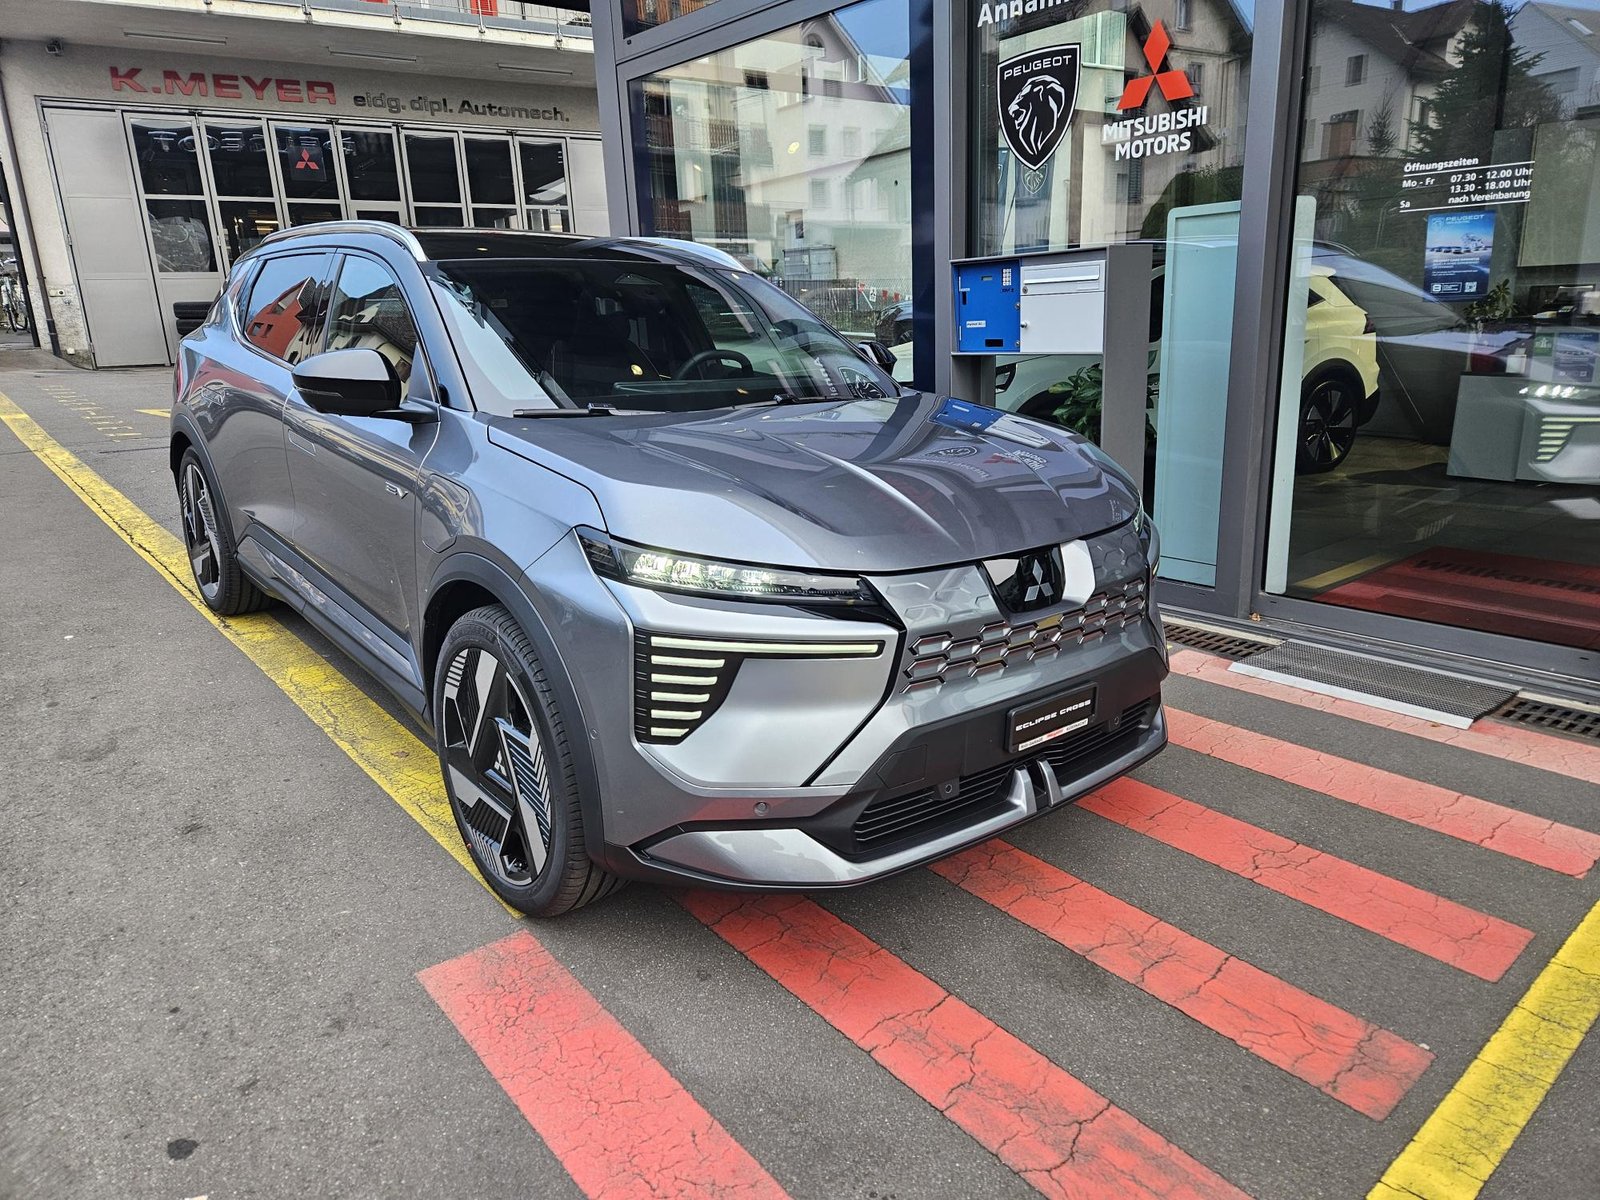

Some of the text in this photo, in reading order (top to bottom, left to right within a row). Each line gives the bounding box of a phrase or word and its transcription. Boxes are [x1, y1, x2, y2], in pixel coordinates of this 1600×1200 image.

[1003, 54, 1072, 80] PEUGEOT
[109, 66, 337, 105] K.MEYER
[353, 92, 570, 122] eidg. dipl. Automech.
[1102, 105, 1207, 141] MITSUBISHI
[1115, 131, 1191, 161] MOTORS
[1402, 180, 1417, 188] Mo
[1425, 177, 1435, 186] Fr
[1450, 173, 1477, 183] 07.30
[1486, 169, 1512, 179] 12.00
[1515, 167, 1534, 176] Uhr
[1403, 157, 1479, 173] Öffnungszeiten
[1400, 190, 1531, 209] Sa nach Vereinbarung
[1450, 184, 1476, 194] 13.30
[1485, 180, 1511, 189] 18.00
[1513, 178, 1532, 187] Uhr
[1015, 711, 1057, 732] ECLIPSE
[1060, 699, 1091, 715] CROSS
